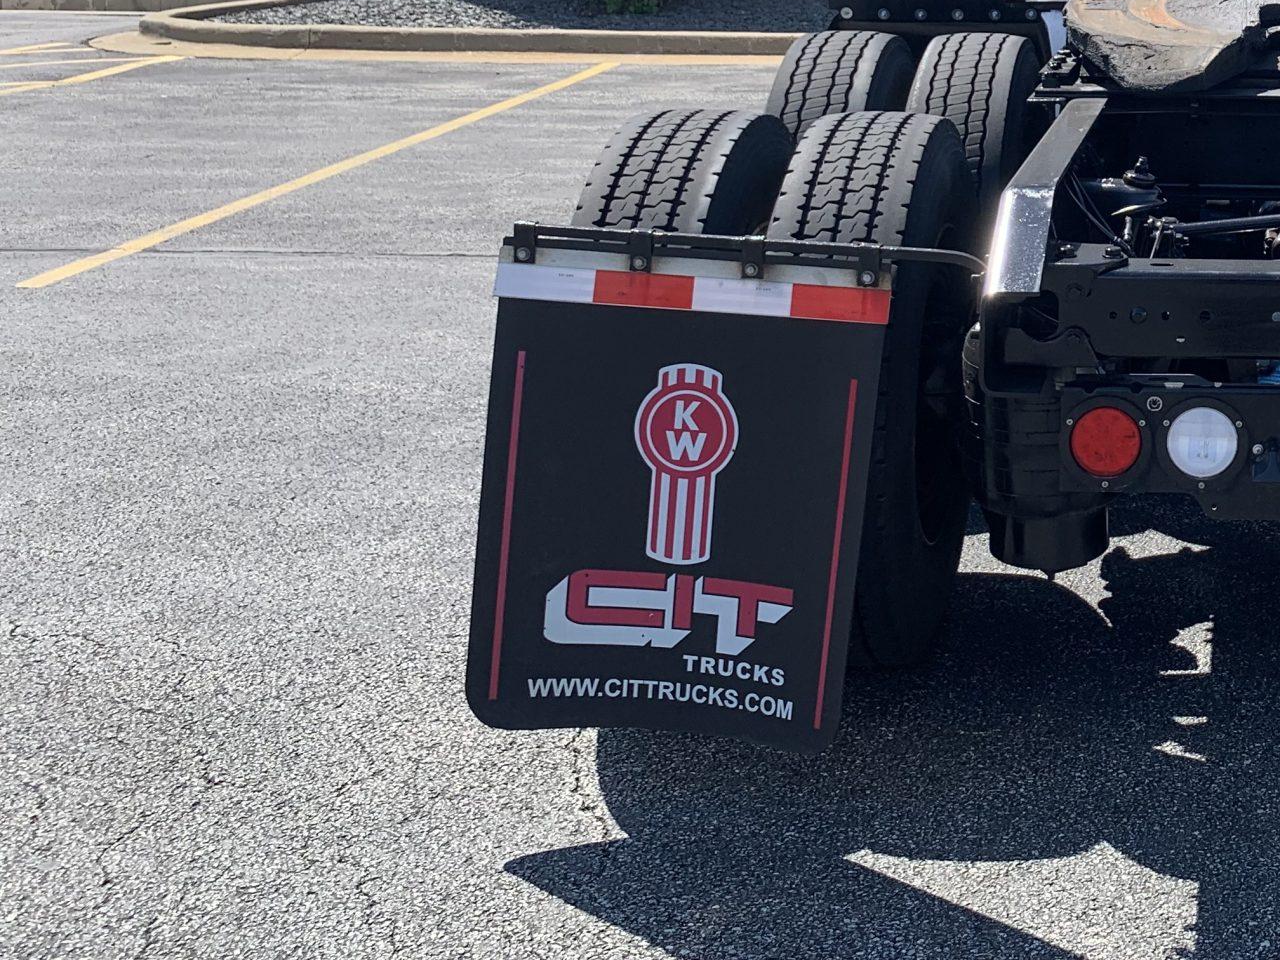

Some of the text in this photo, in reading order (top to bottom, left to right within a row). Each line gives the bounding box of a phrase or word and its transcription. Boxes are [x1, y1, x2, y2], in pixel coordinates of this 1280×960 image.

[543, 569, 794, 655] CIT
[683, 655, 785, 685] TRUCKS
[527, 678, 793, 721] WWW.CITTRUCKS.COM
